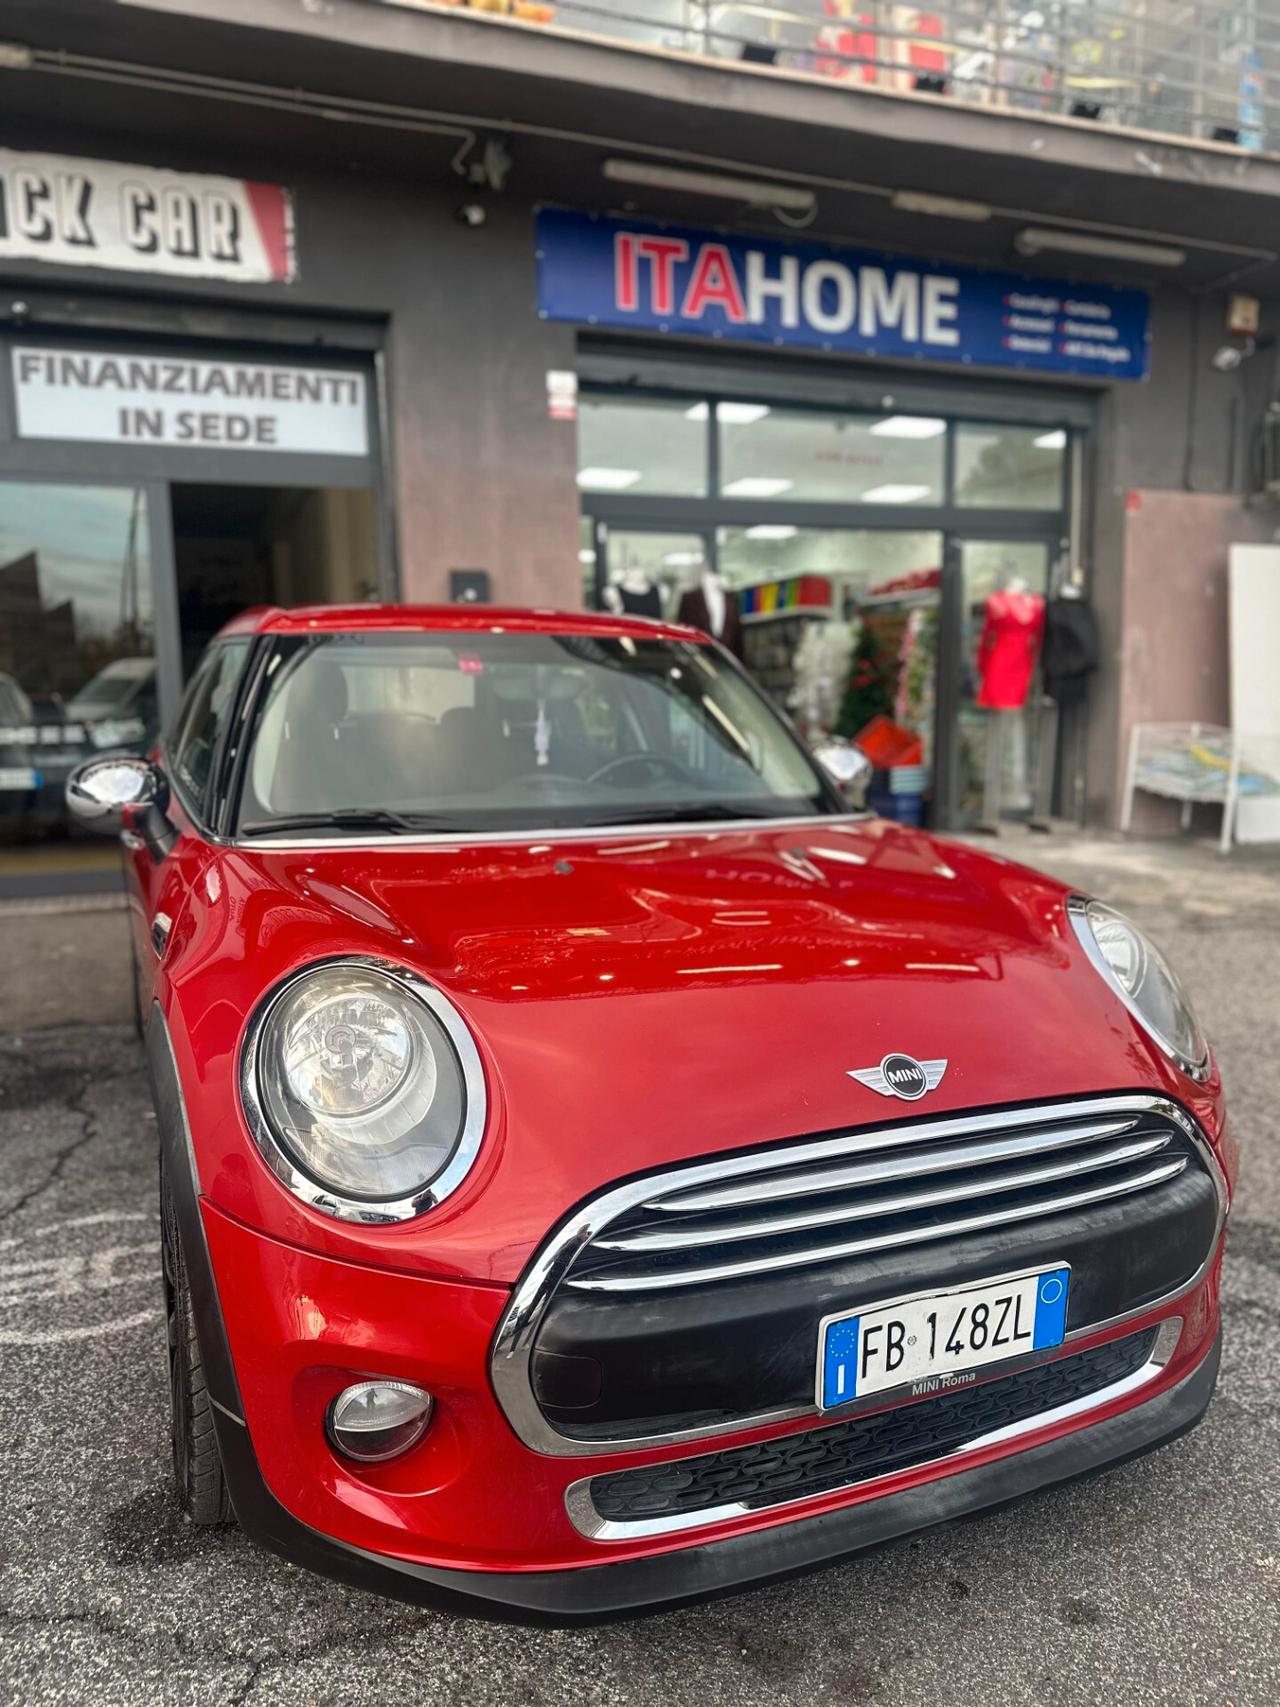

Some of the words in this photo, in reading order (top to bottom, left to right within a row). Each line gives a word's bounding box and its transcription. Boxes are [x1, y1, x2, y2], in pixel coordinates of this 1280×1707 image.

[0, 168, 97, 247] CK
[119, 180, 241, 263] CAR
[614, 231, 960, 347] ITAHOME
[18, 354, 358, 404] FINANZIAMENTI
[119, 408, 164, 438] IN
[176, 410, 278, 444] SEDE
[887, 1068, 923, 1084] MINI
[837, 1364, 845, 1394] I
[911, 1379, 940, 1396] MINI
[942, 1372, 976, 1389] Roma
